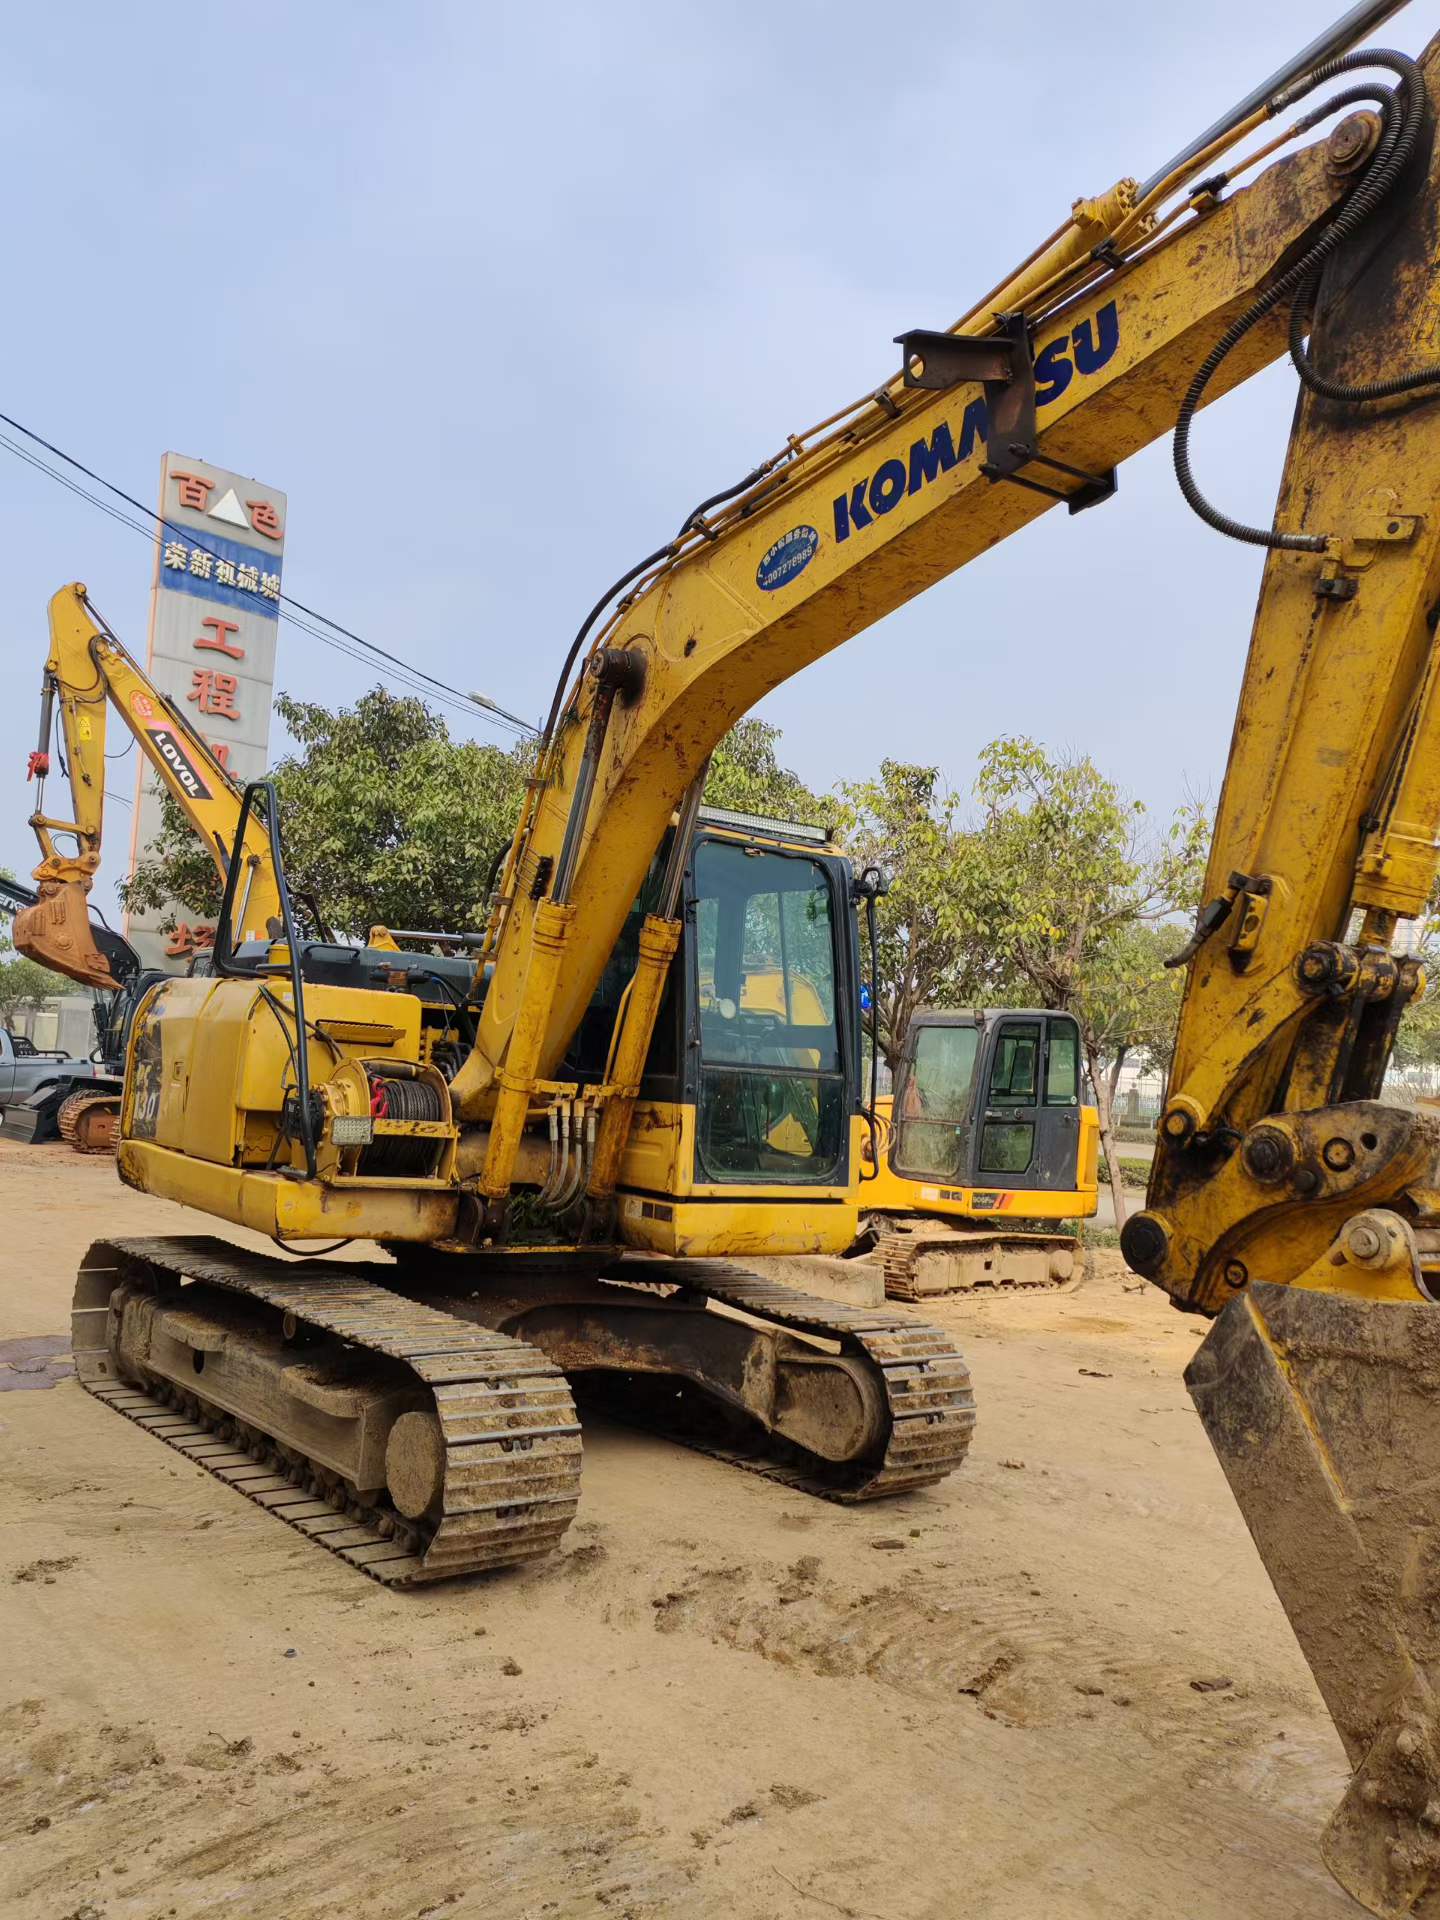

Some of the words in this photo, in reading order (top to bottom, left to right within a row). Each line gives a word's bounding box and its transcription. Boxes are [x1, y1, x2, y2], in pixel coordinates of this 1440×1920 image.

[833, 300, 1120, 543] KOMASU
[170, 470, 216, 512] 百
[246, 500, 284, 541] 色
[163, 541, 281, 601] 荣新机械城
[155, 732, 199, 797] LOVOL
